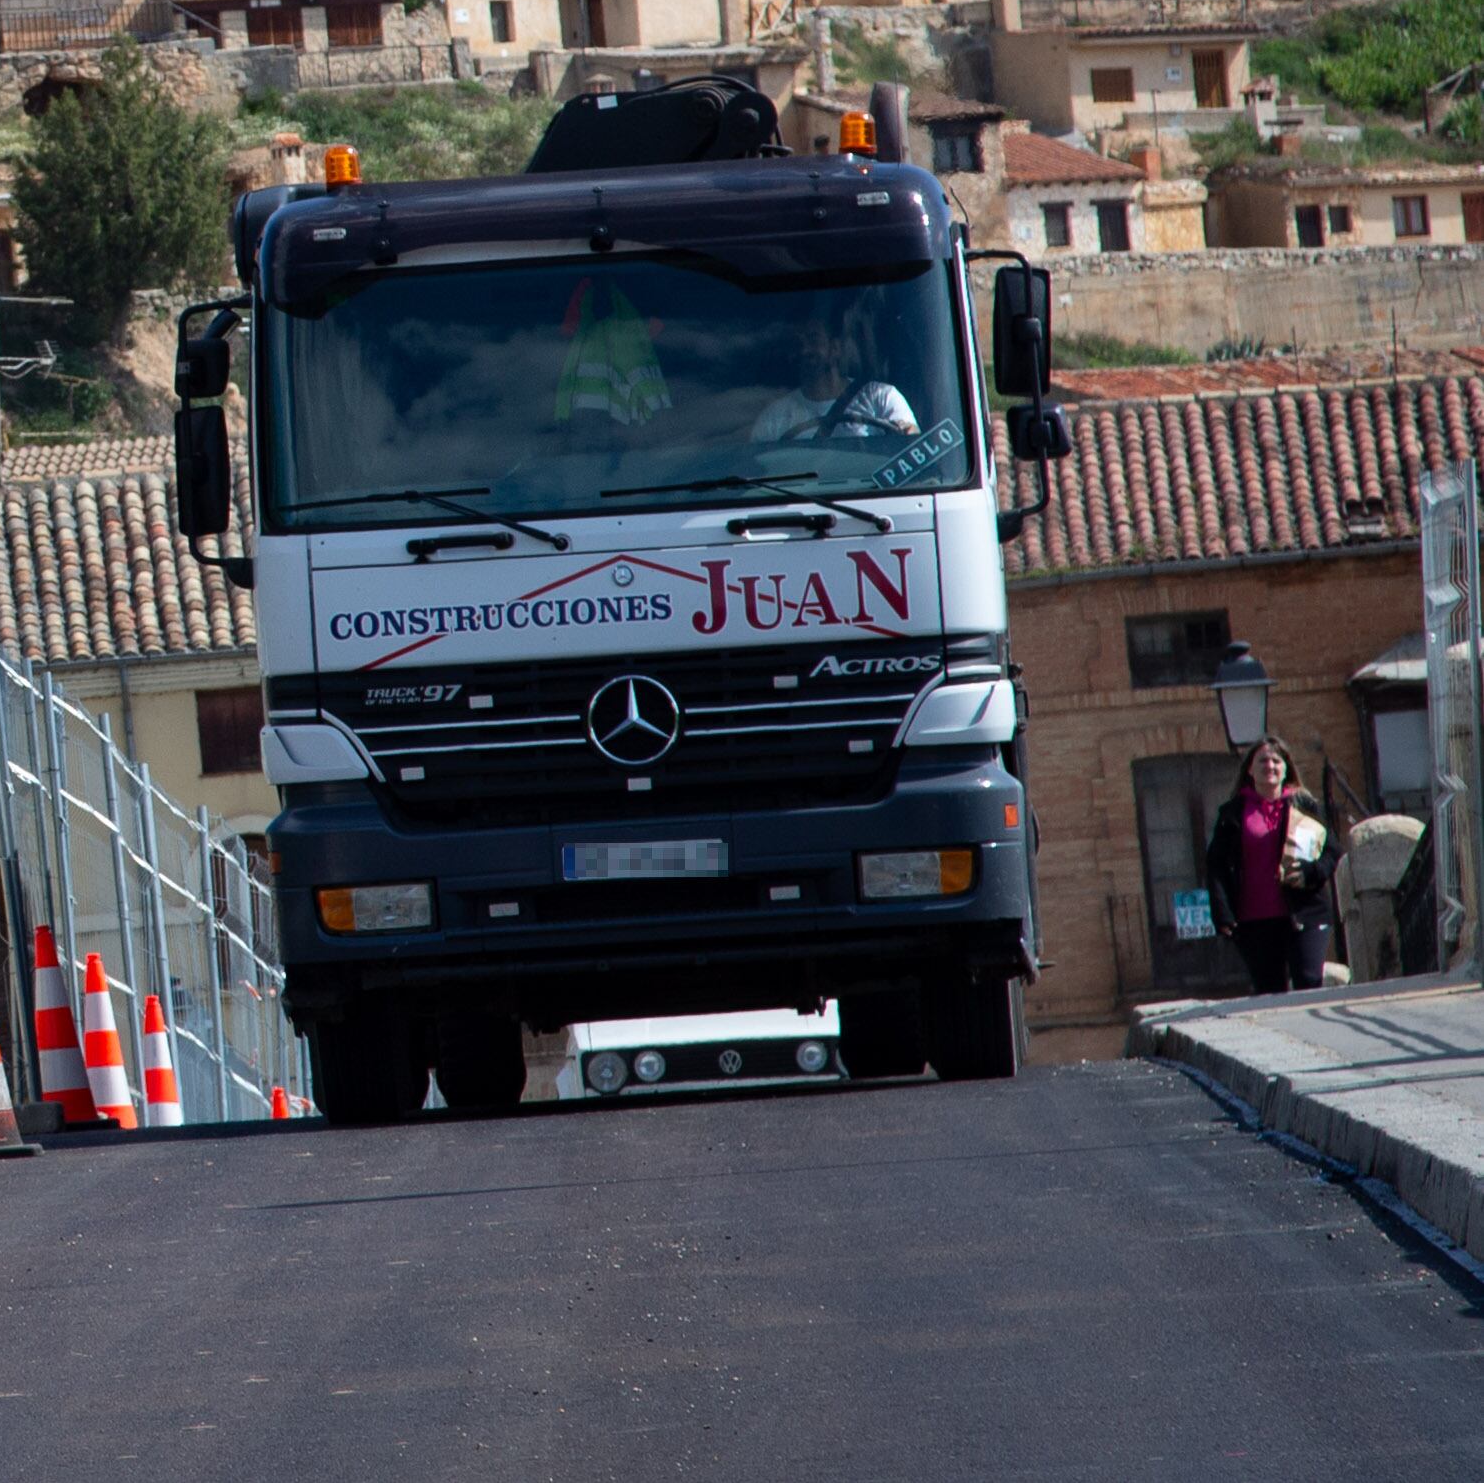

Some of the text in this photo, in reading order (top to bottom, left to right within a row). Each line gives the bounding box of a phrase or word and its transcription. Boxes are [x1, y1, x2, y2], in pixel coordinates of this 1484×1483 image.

[882, 428, 954, 486] PABLO
[329, 547, 914, 641] CONSTRUCCIONES JUAN
[366, 686, 418, 700] TRUCK
